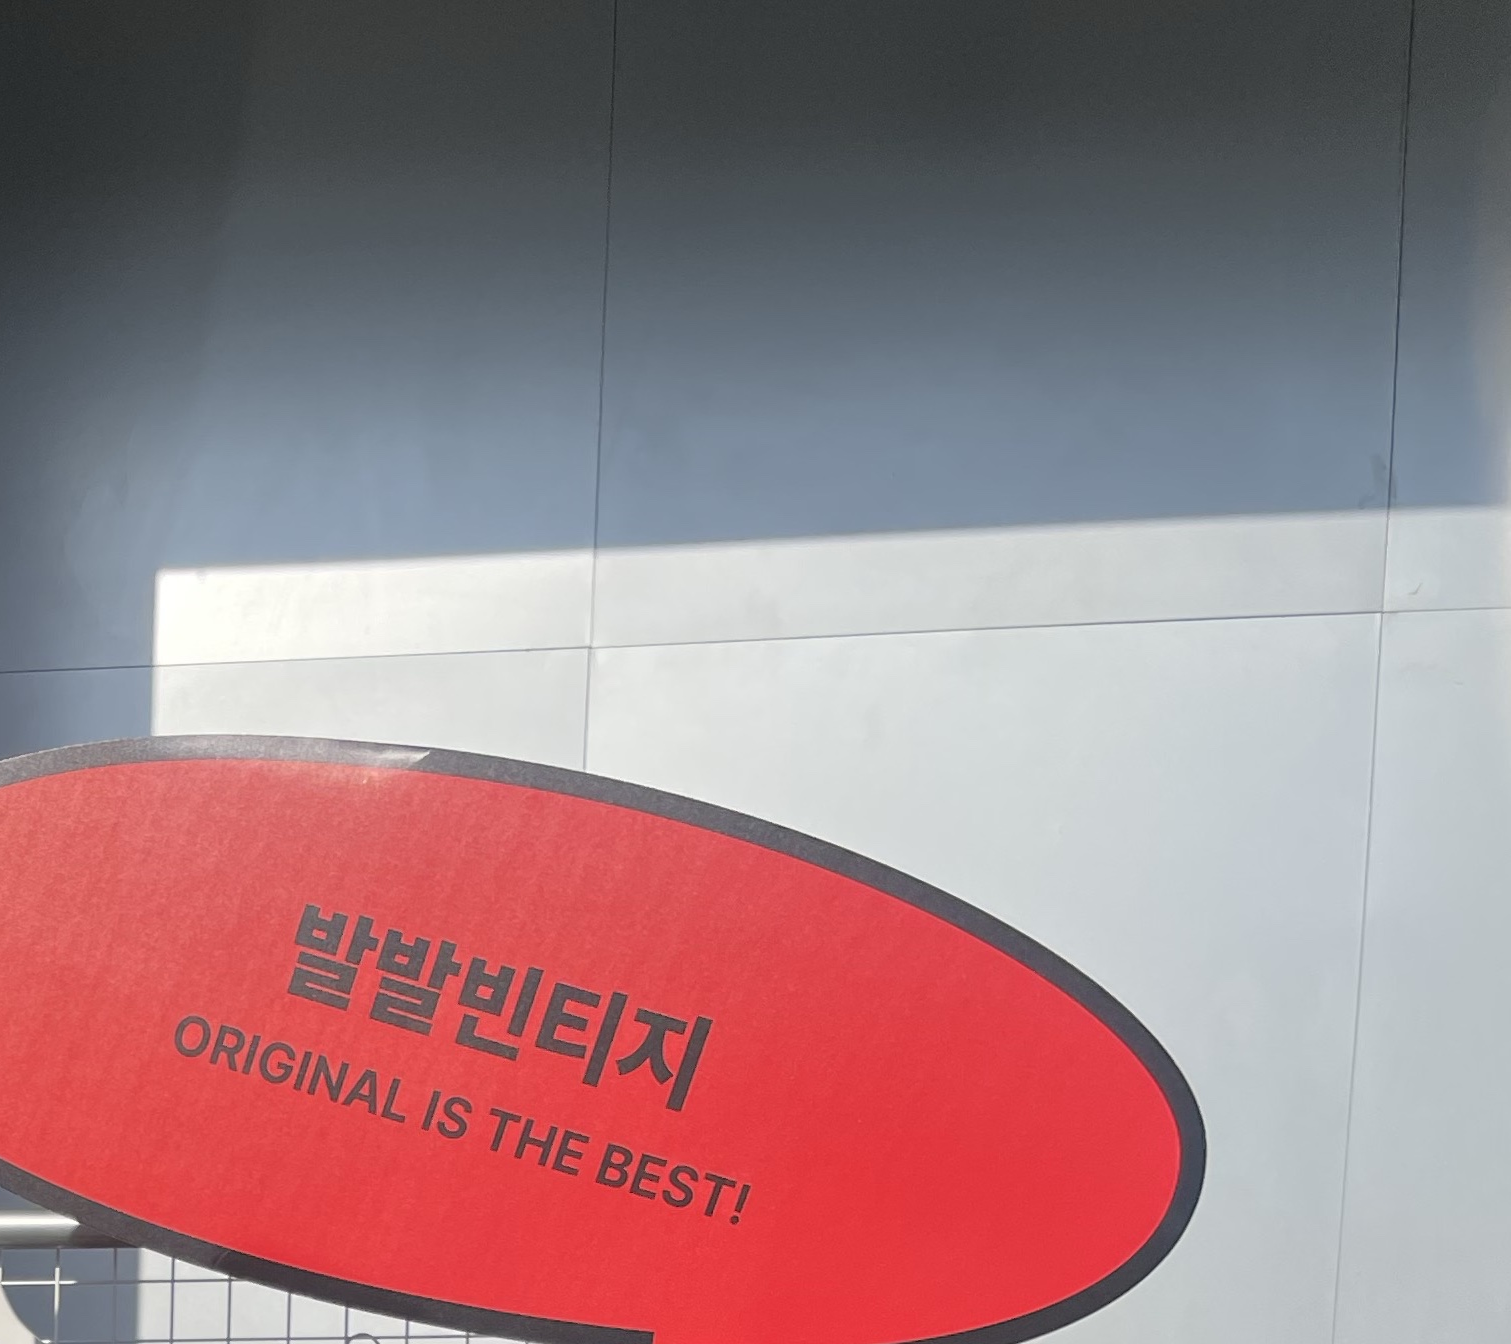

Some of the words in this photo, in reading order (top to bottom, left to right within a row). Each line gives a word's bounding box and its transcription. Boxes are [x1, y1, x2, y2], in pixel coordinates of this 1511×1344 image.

[287, 903, 714, 1112] 발발빈티지
[174, 1015, 407, 1125] ORIGINAL
[420, 1090, 473, 1139] IS
[489, 1107, 590, 1176] THE
[595, 1142, 751, 1226] BEST!
